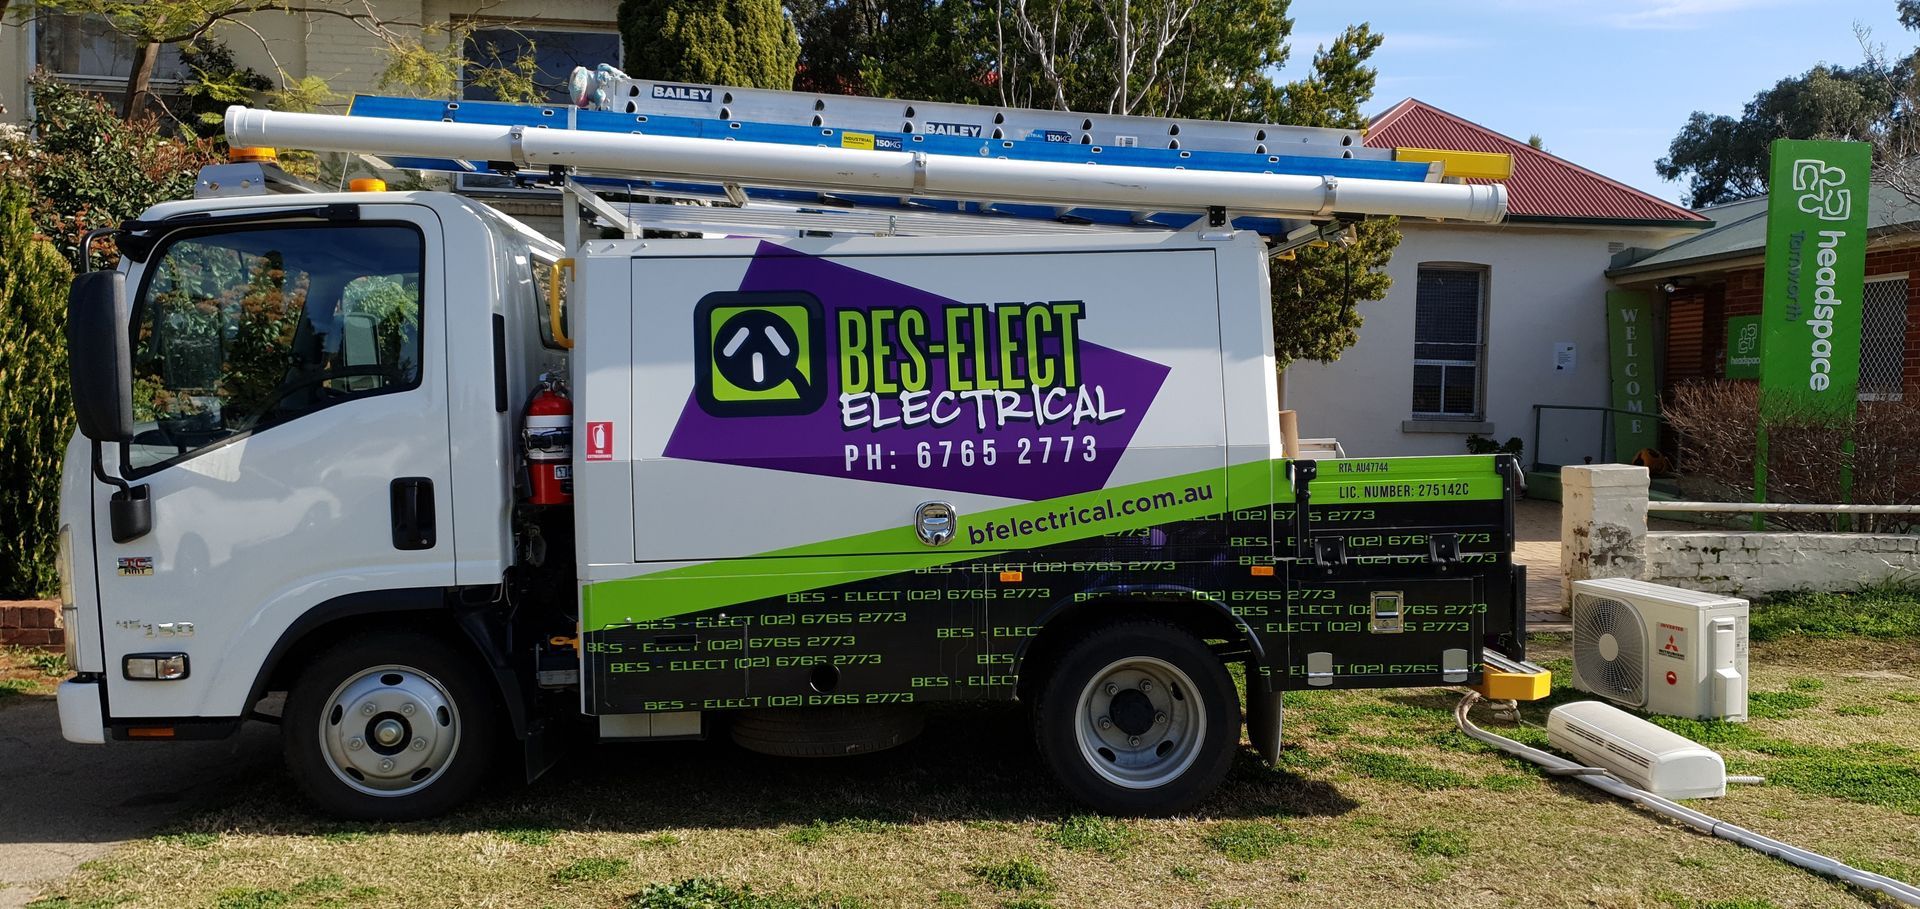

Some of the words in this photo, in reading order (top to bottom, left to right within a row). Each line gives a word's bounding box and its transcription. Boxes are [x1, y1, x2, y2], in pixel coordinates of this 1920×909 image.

[653, 86, 711, 101] BAILEY
[925, 123, 980, 138] BAILEY
[1047, 133, 1073, 143] 130KG
[844, 136, 872, 144] INDUSTRIAL
[876, 139, 901, 149] 150KG
[1785, 230, 1806, 322] Tamworth
[1806, 231, 1846, 391] headspace
[839, 303, 1081, 393] BES-ELECT
[1621, 308, 1643, 434] WELCOME
[839, 384, 1126, 430] ELECTRICAL
[845, 443, 897, 471] PH:
[916, 439, 997, 469] 6765
[1017, 435, 1097, 465] 2773
[1356, 462, 1388, 473] AU47744
[1340, 486, 1359, 499] LIC.
[1364, 484, 1414, 498] NUMBER:
[1418, 482, 1469, 496] 275142C
[968, 484, 1213, 545] bfelectrical.com.au
[1233, 509, 1267, 521] (02)
[1272, 509, 1322, 522] 675
[1328, 510, 1376, 521] 2773
[1231, 536, 1268, 547] BES
[1349, 535, 1383, 547] (02)
[1458, 533, 1490, 544] 773
[1240, 555, 1276, 565] BES
[1462, 552, 1497, 563] 773
[972, 563, 1027, 574] ELECT
[1033, 562, 1067, 574] (02)
[1072, 561, 1123, 572] 6765
[1128, 560, 1176, 571] 2773
[787, 593, 825, 604] BES
[845, 591, 901, 602] ELECT
[907, 589, 942, 602] (02)
[947, 588, 997, 600] 6765
[1003, 588, 1050, 599] 2773
[1191, 590, 1226, 601] (02)
[1231, 590, 1285, 602] 6765
[1287, 589, 1336, 600] 2773
[1231, 606, 1269, 617] BES
[1288, 605, 1348, 616] ELECT
[1403, 604, 1438, 615] 765
[1443, 603, 1488, 615] 2773
[696, 615, 755, 629] ELECT
[760, 614, 795, 626] (02)
[801, 613, 853, 624] 6765
[858, 612, 907, 623] 2773
[1266, 622, 1322, 633] ELECT
[1327, 621, 1362, 632] (02)
[1423, 621, 1469, 632] 2773
[937, 627, 974, 638] BES
[993, 626, 1044, 637] ELEC
[587, 641, 624, 654] BES
[707, 638, 744, 651] (02)
[750, 637, 801, 648] 6765
[807, 635, 856, 647] 2773
[610, 662, 650, 673] BES
[670, 659, 729, 671] ELECT
[734, 657, 769, 669] (02)
[776, 656, 828, 667] 6765
[834, 654, 883, 665] 2773
[977, 654, 1014, 665] BES
[1350, 664, 1384, 675] (02)
[1391, 663, 1439, 673] 6765
[912, 677, 949, 688] BES
[644, 700, 685, 711] BES
[703, 697, 763, 709] ELECT
[768, 695, 803, 707] (02)
[808, 695, 860, 706] 6765
[866, 692, 915, 704] 2773
